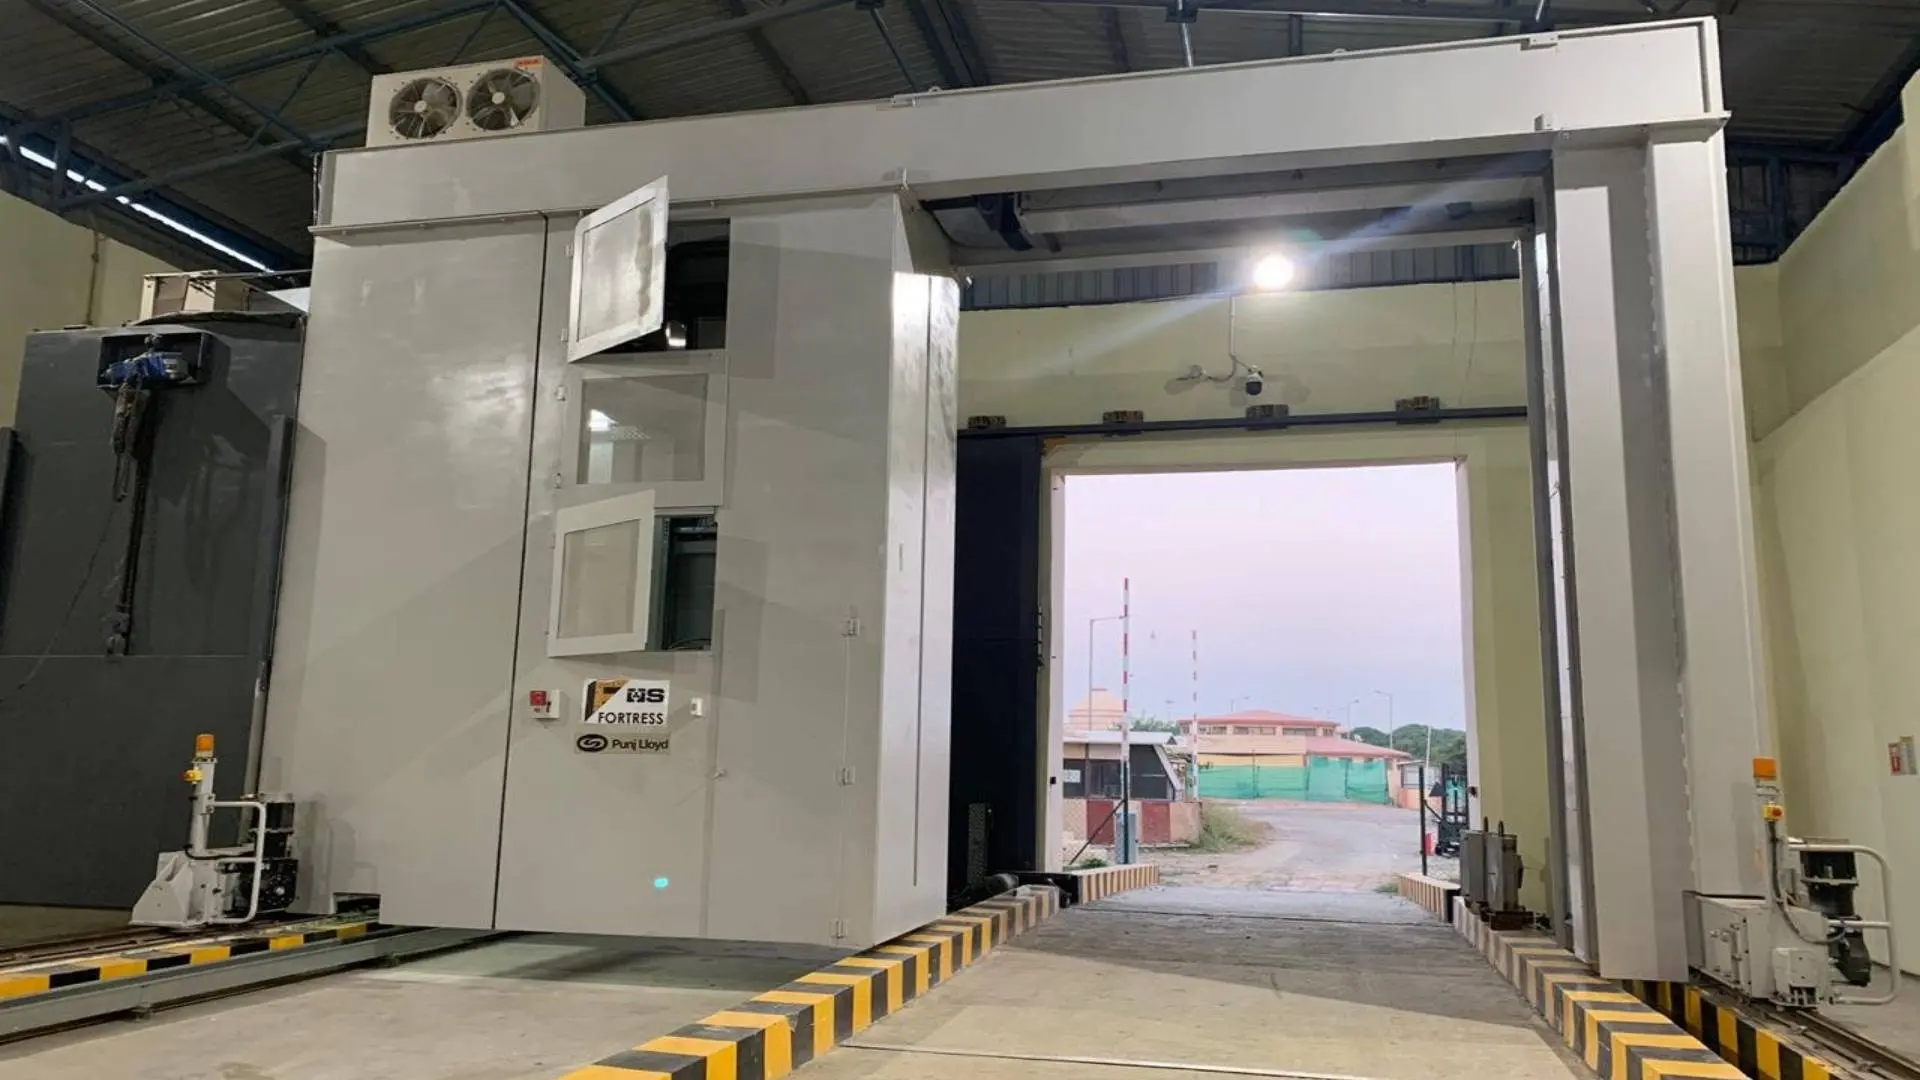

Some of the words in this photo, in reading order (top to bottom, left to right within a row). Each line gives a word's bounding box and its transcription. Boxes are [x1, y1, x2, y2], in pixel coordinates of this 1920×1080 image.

[598, 712, 664, 725] FORTRESS
[612, 738, 636, 752] Punj
[638, 738, 668, 751] Lloyd
